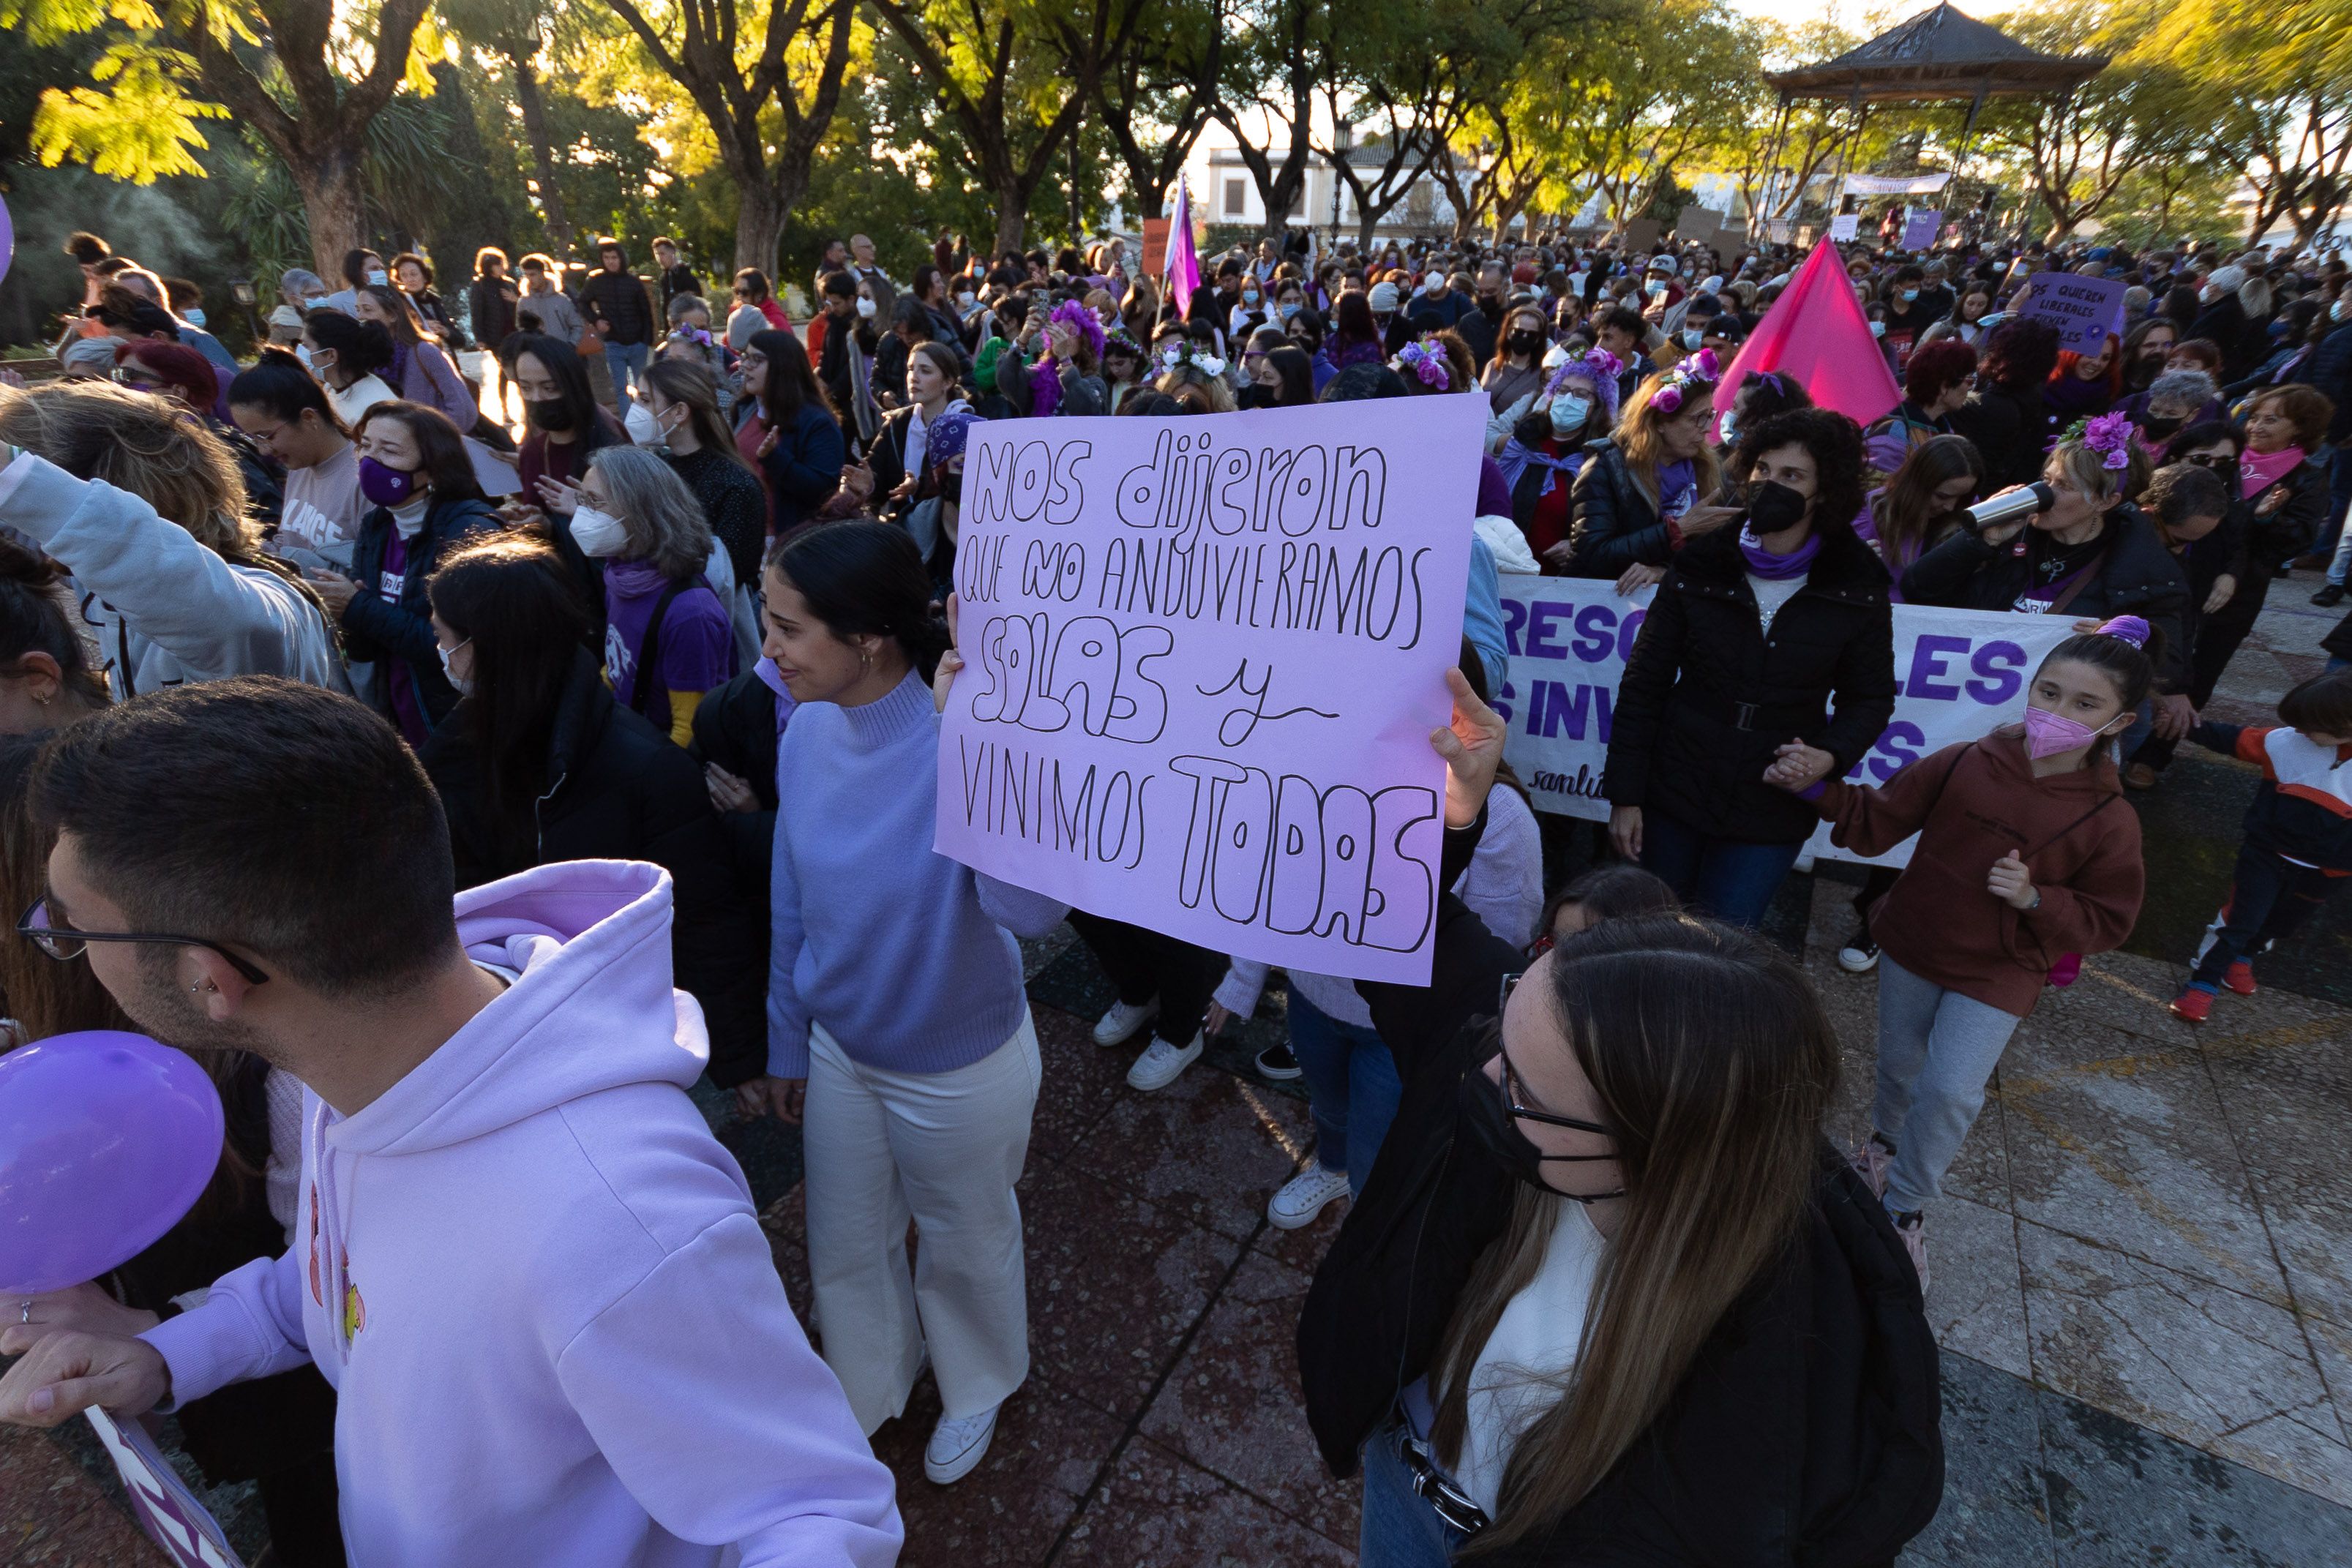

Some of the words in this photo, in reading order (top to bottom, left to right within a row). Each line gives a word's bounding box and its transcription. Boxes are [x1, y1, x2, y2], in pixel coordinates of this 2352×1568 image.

[2039, 299, 2096, 318] LIBERALES
[2059, 285, 2107, 304] QUIEREN
[972, 440, 1093, 525] NOS
[1115, 428, 1388, 555] dijeron
[962, 534, 1011, 604] QUE
[1022, 539, 1086, 602] NO
[1098, 536, 1432, 650] ANDUVIERAMOS
[971, 612, 1175, 743] SOLAS
[1196, 657, 1341, 747] y
[960, 734, 1156, 870] VINIMOS
[1169, 754, 1439, 953] TODAS
